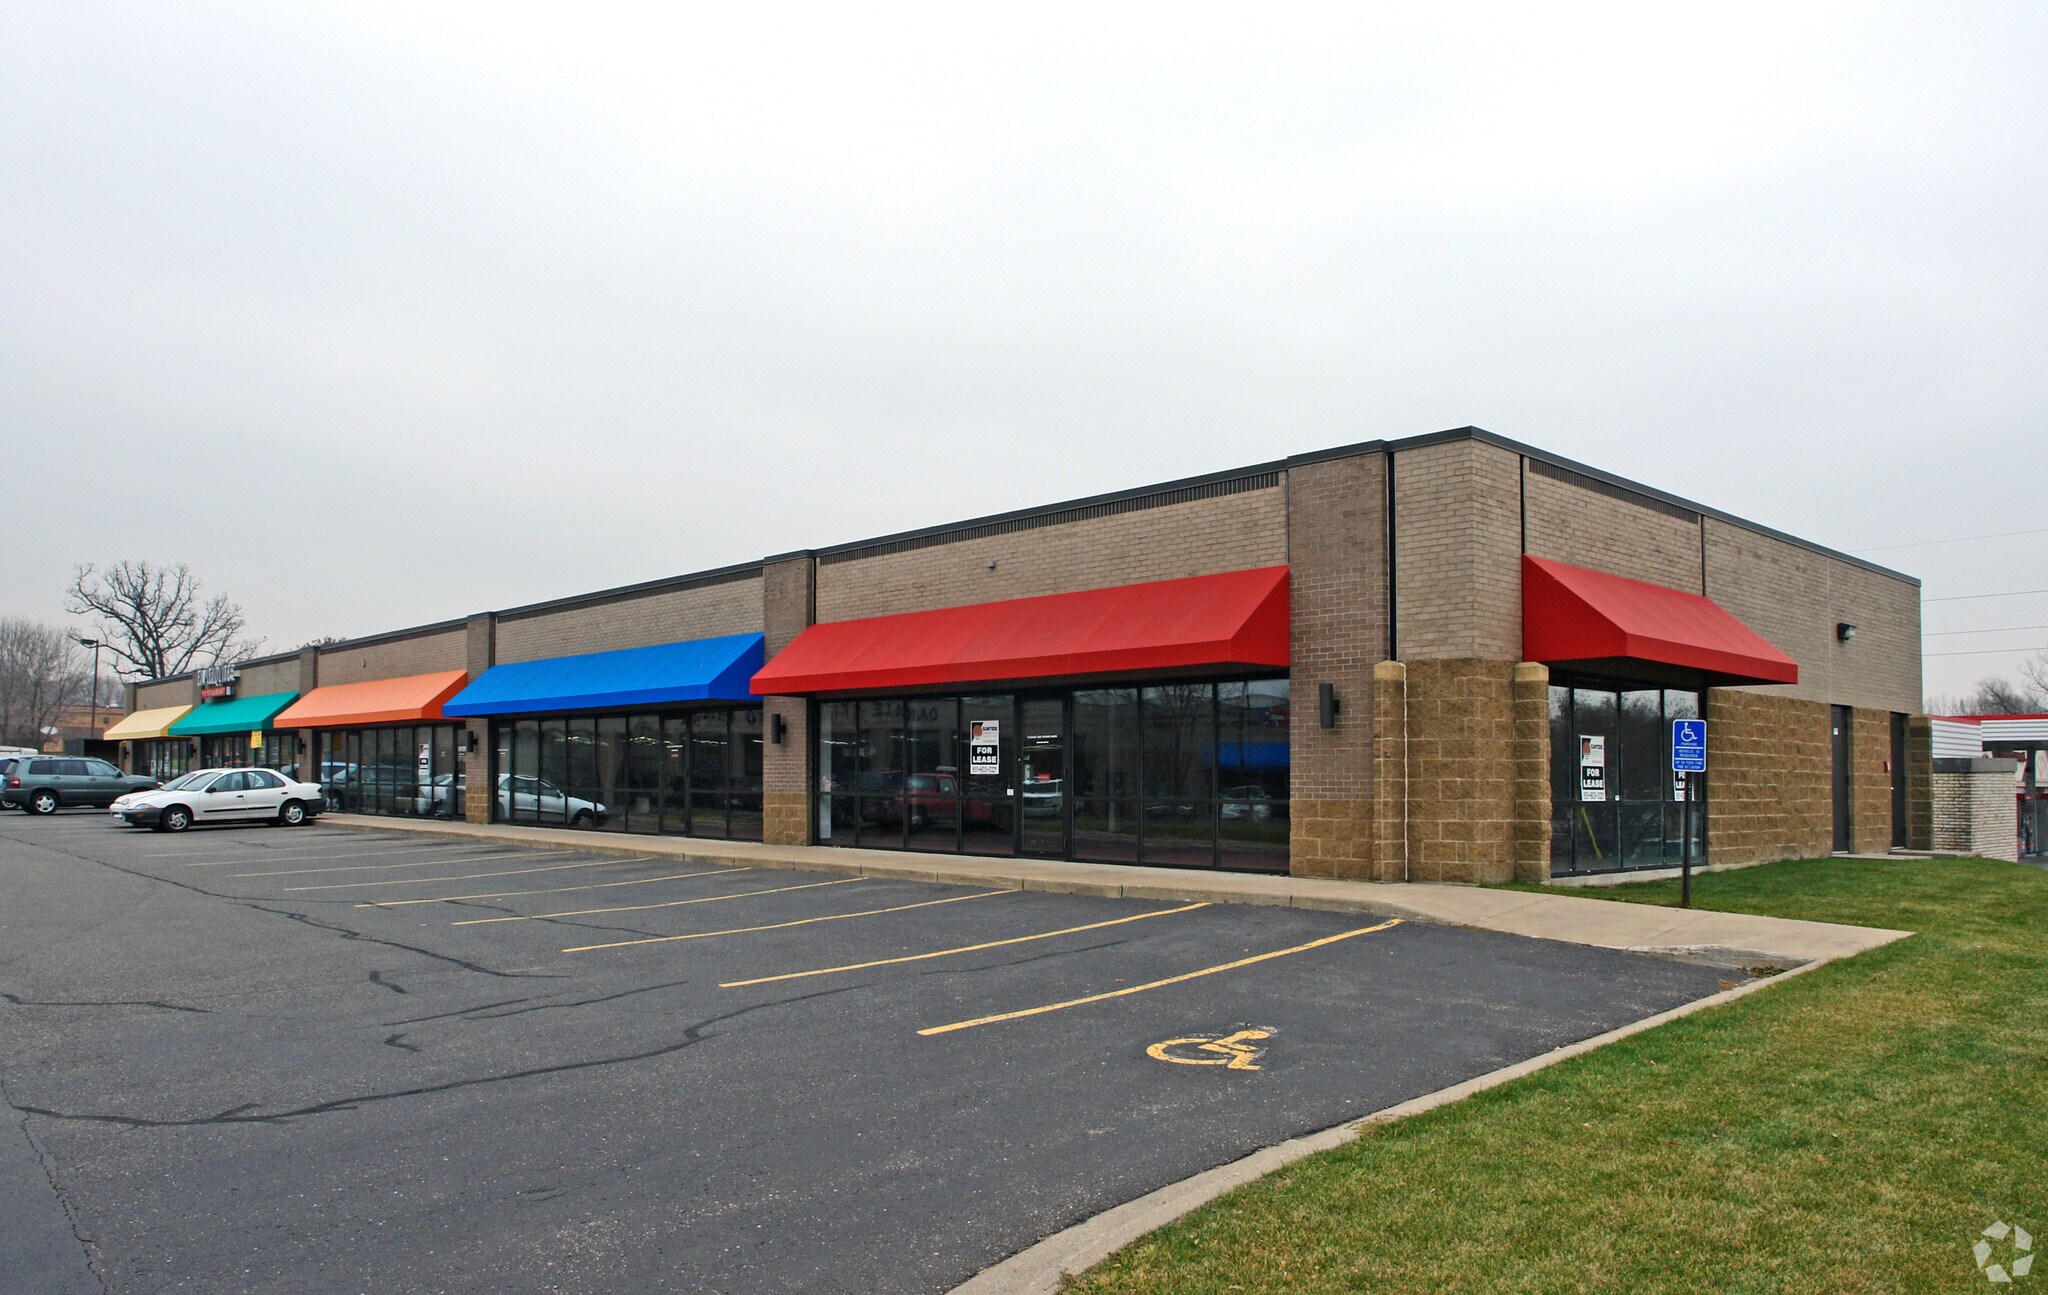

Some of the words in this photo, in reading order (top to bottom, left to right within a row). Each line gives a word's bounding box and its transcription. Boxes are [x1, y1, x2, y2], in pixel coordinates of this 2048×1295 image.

[976, 746, 993, 755] FOR
[972, 755, 997, 764] LEASE
[1586, 768, 1600, 777] FOR
[1583, 779, 1604, 788] LEASE
[1675, 781, 1685, 789] LEA
